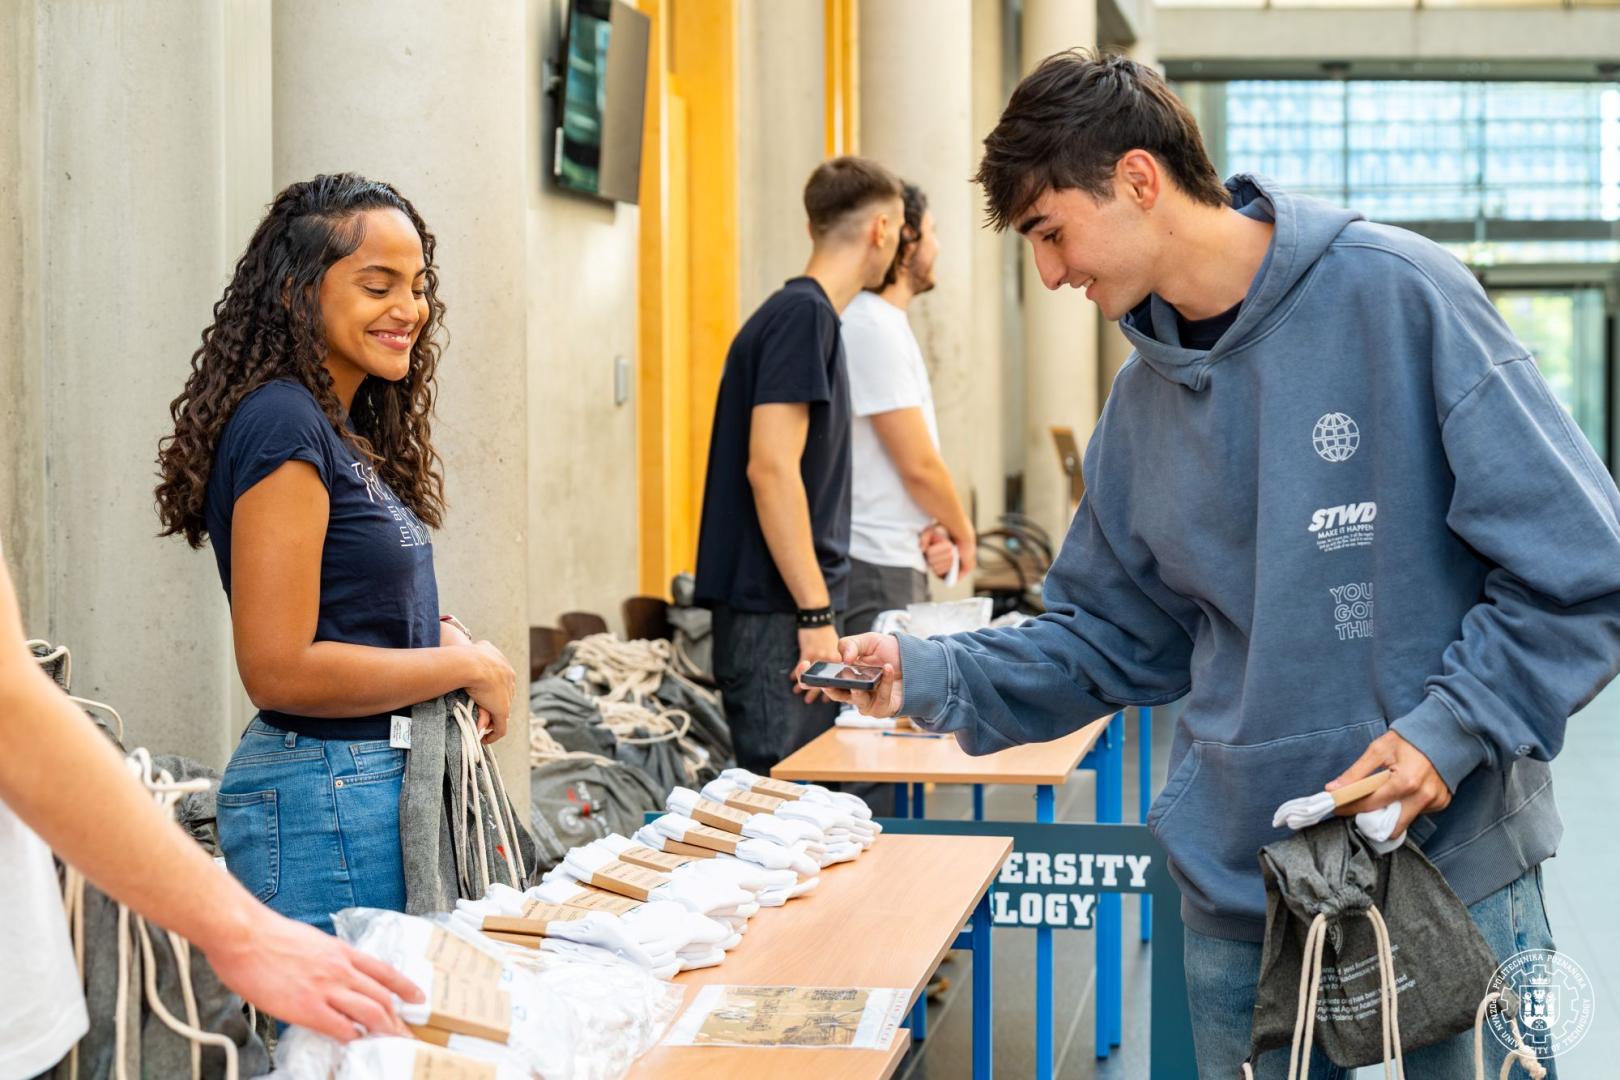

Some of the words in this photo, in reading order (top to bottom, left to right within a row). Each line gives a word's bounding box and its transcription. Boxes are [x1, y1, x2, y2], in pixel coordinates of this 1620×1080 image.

[1308, 502, 1377, 532] STWD
[1317, 528, 1338, 539] MAKE
[1346, 524, 1374, 533] HAPPEN
[1329, 582, 1374, 604] YOU
[999, 852, 1151, 887] ERSITY
[993, 891, 1095, 926] LOGY
